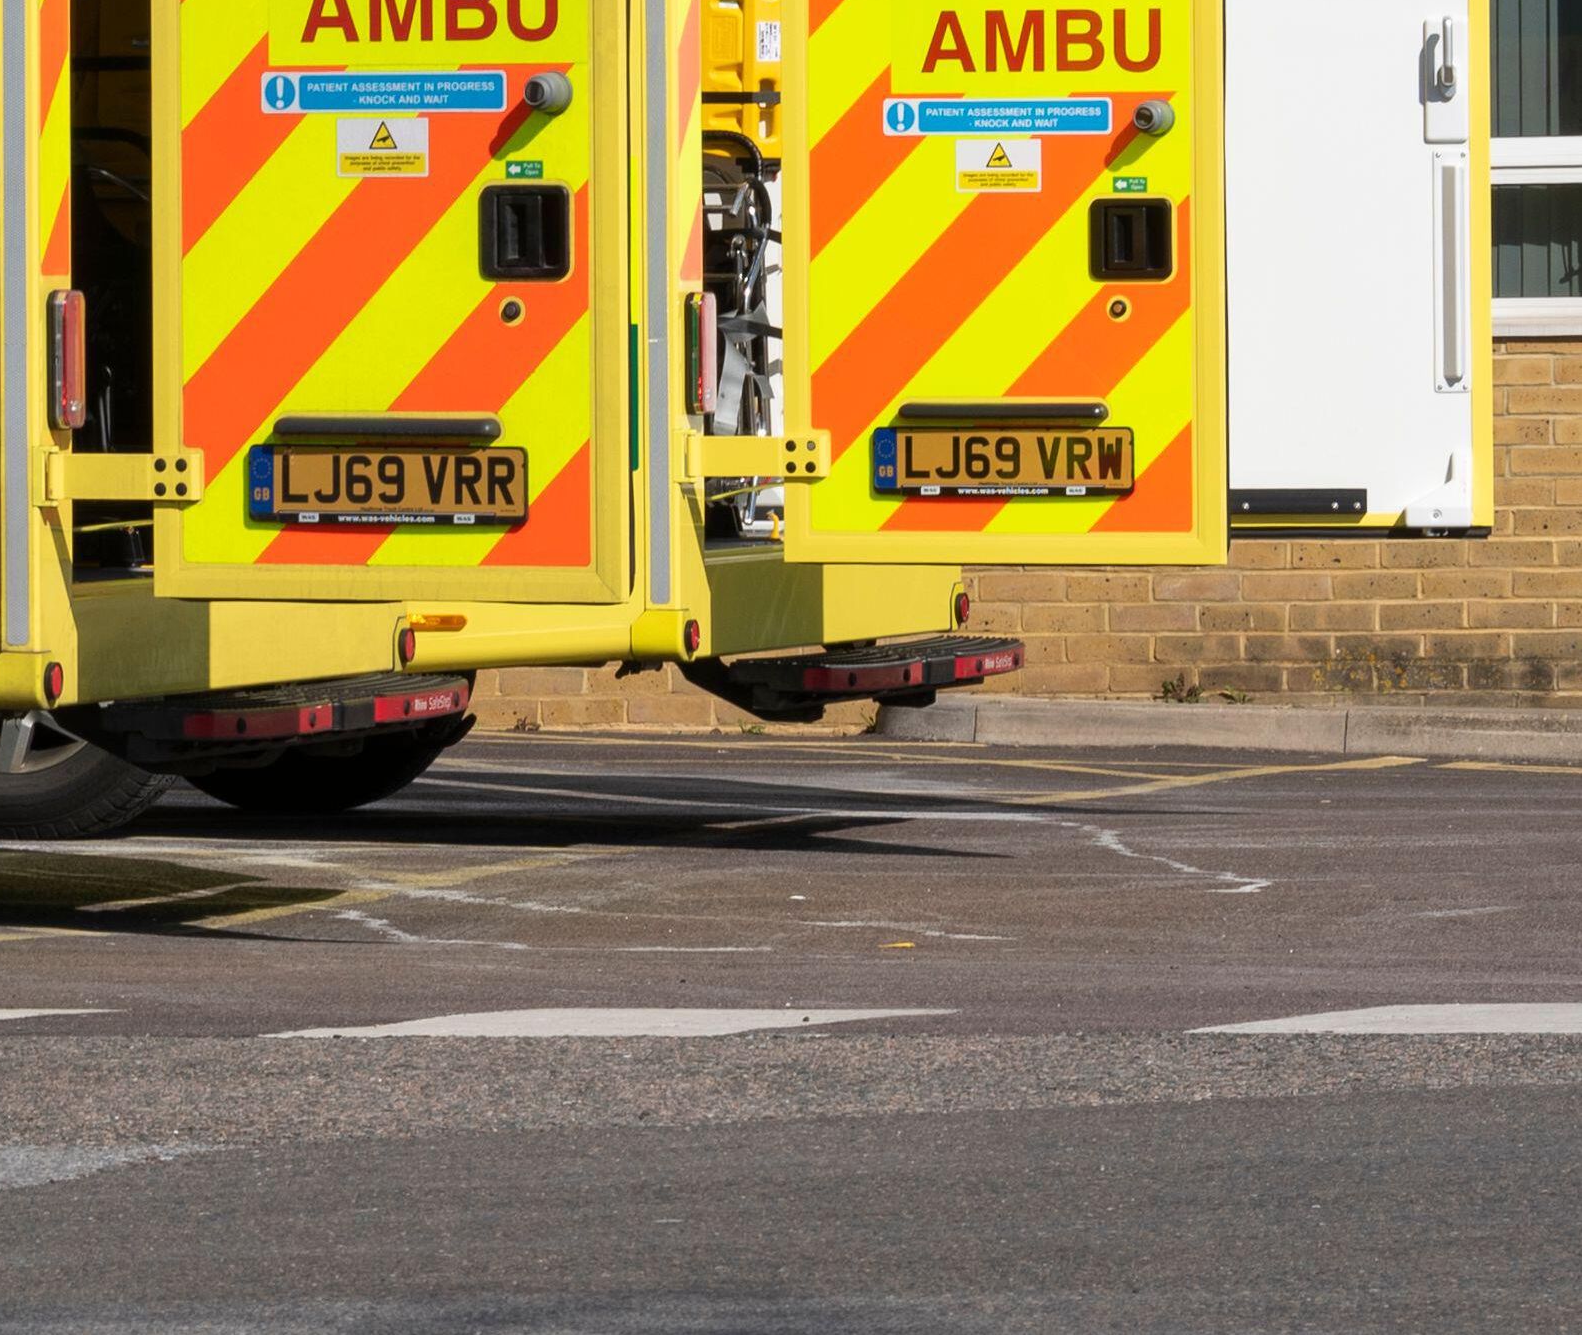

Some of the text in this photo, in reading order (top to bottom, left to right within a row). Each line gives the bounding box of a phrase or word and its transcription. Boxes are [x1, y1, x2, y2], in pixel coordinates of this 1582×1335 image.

[921, 8, 1162, 73] AMBU
[307, 81, 496, 93] PATIENT ASSESSMENT IN PROGRESS
[359, 95, 397, 105] KNOCK
[399, 95, 421, 105] AND
[423, 94, 449, 105] WAIT
[925, 106, 1102, 117] PATIENT ASSESSMENT IN PROGRESS
[974, 119, 1009, 128] KNOCK
[1011, 118, 1032, 128] AND
[1034, 118, 1058, 128] WAIT
[905, 435, 1123, 480] LJ69 VRW
[282, 454, 516, 506] LJ69 VRR
[253, 486, 271, 501] GB
